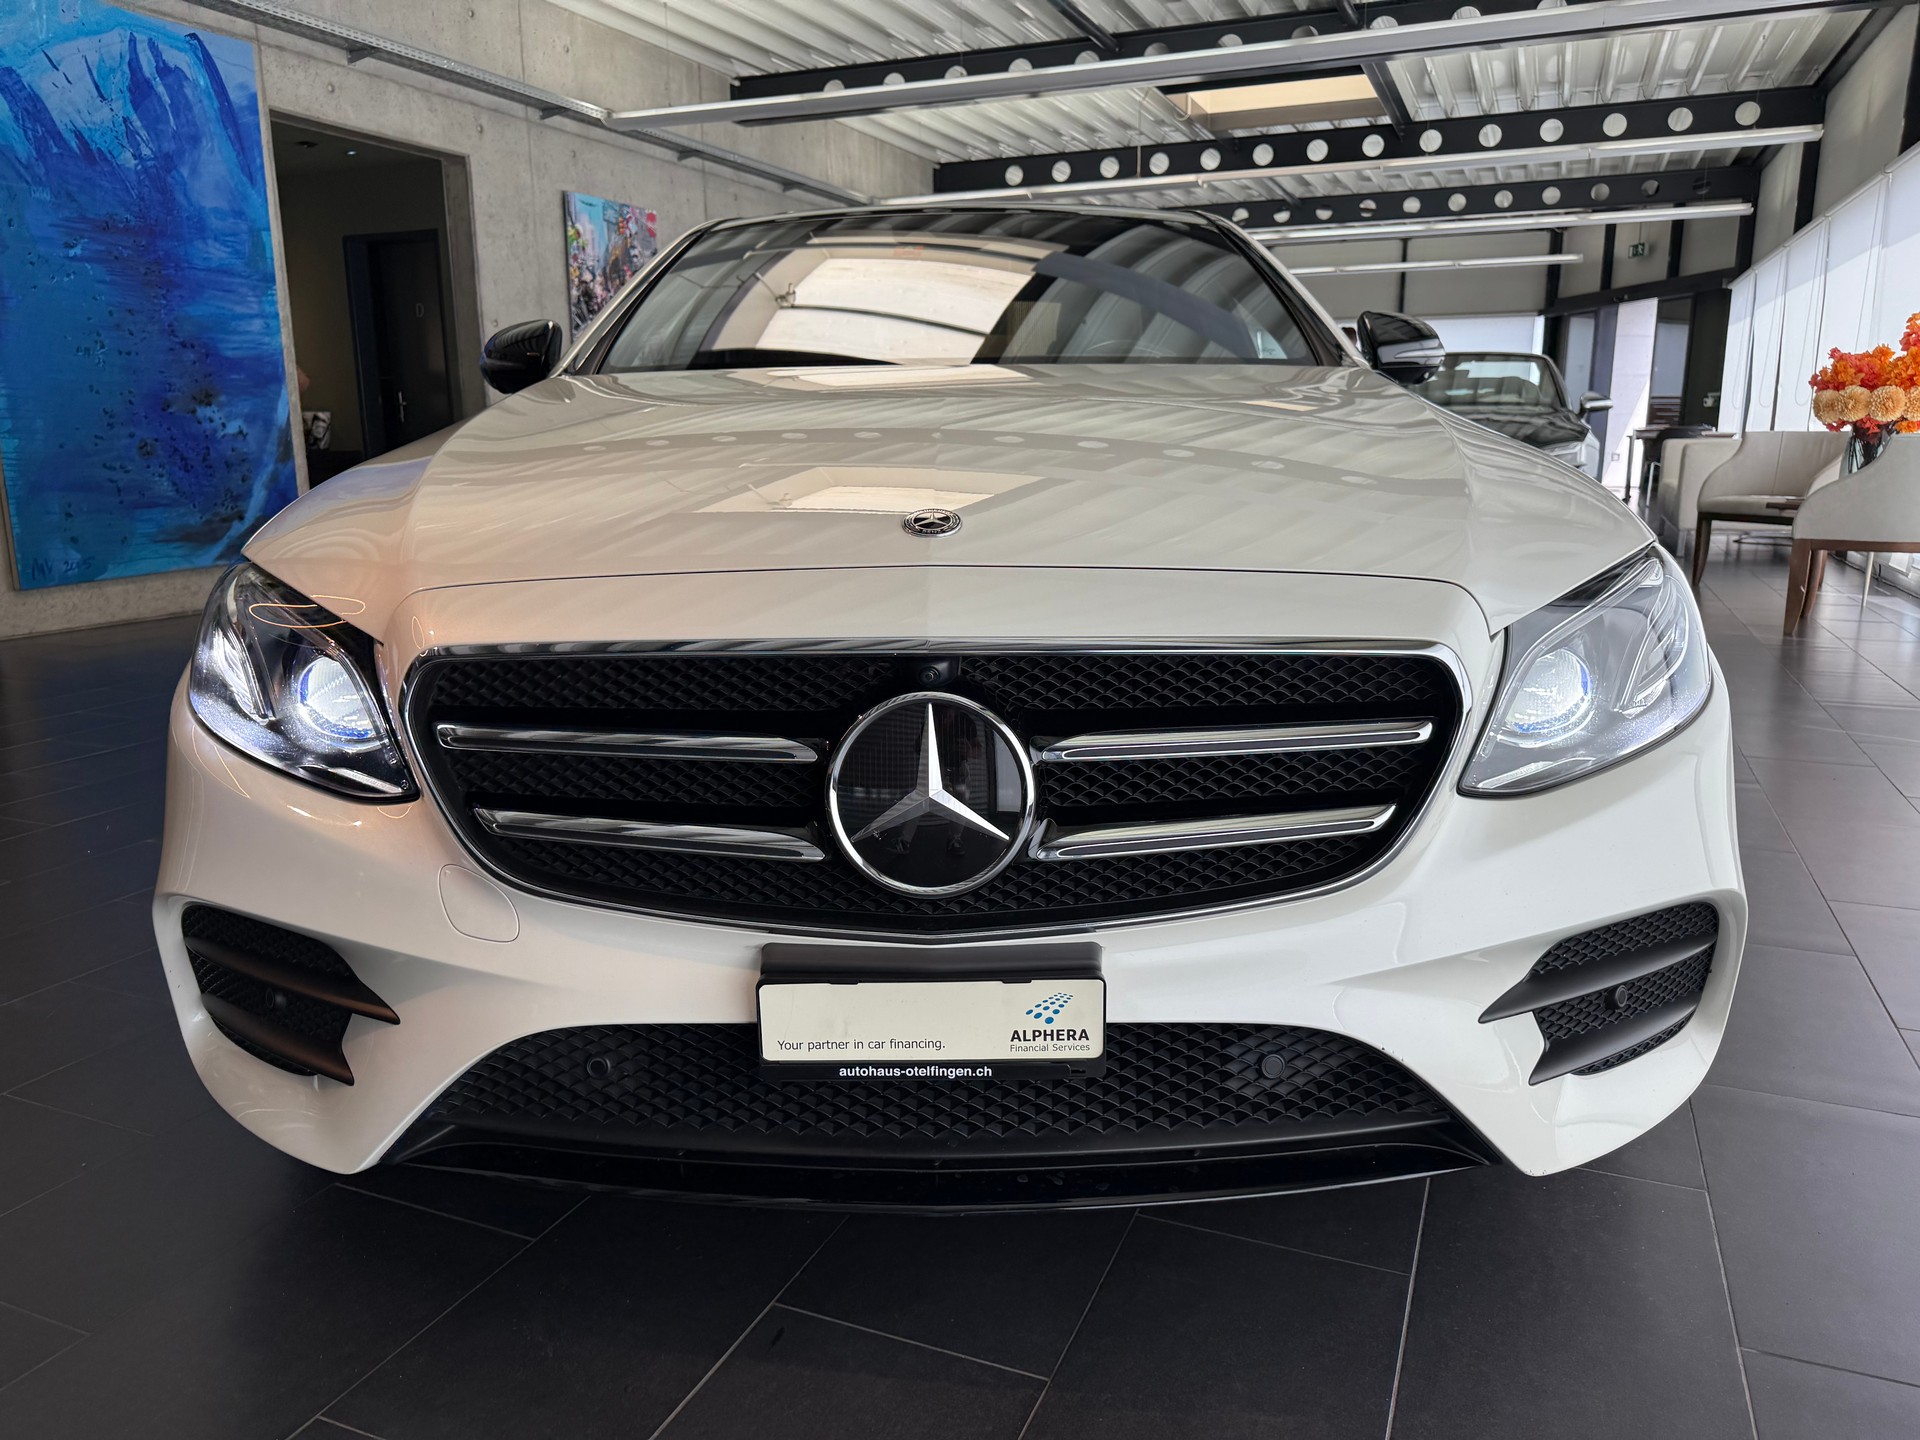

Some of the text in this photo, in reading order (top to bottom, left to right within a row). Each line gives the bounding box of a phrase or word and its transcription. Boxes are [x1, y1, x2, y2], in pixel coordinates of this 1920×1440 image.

[1010, 1028, 1090, 1042] ALPHERA
[777, 1038, 946, 1052] Your partner in car financing.
[1010, 1043, 1090, 1052] Financial Services
[839, 1065, 992, 1079] autohaus-otelfingen.ch
